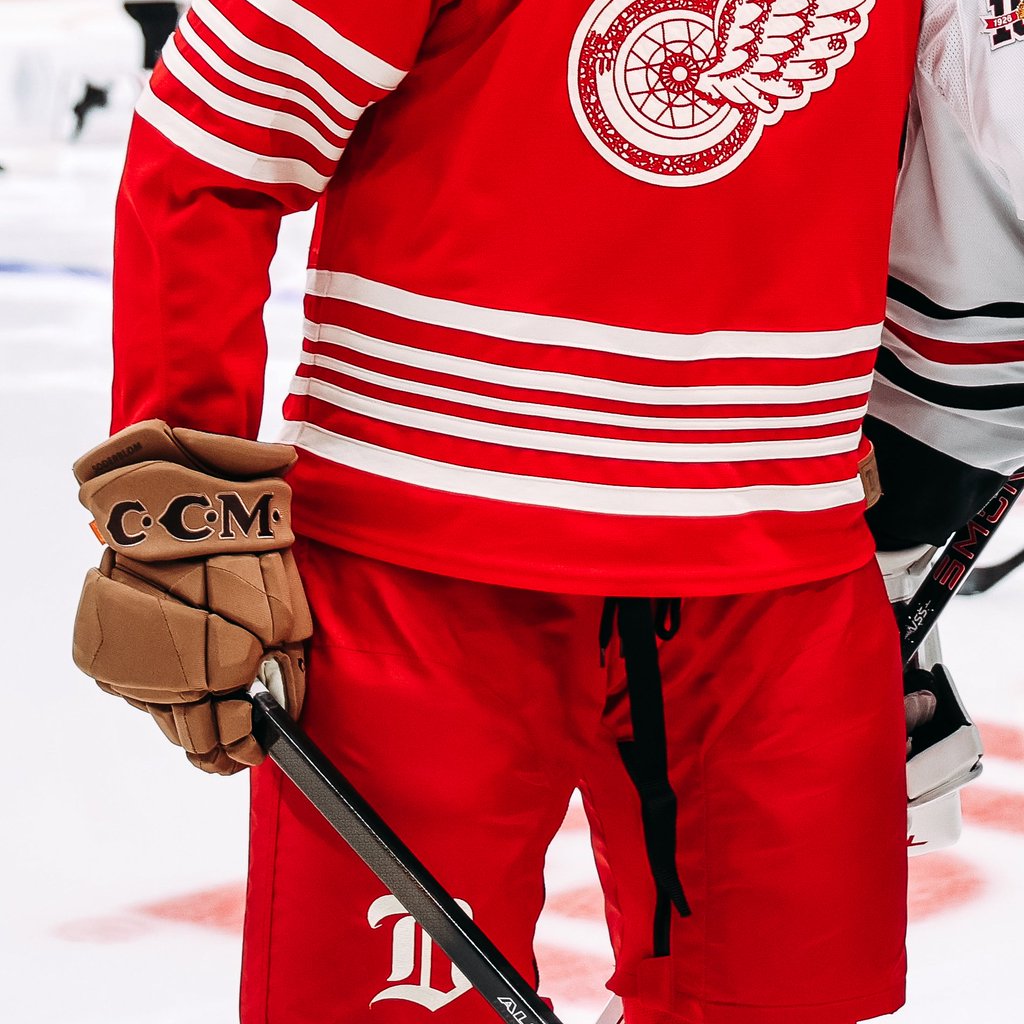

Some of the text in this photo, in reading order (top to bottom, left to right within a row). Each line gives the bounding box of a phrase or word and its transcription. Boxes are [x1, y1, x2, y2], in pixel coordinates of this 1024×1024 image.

[993, 14, 1013, 27] 1926
[366, 893, 475, 1013] D
[496, 996, 534, 1024] AL
